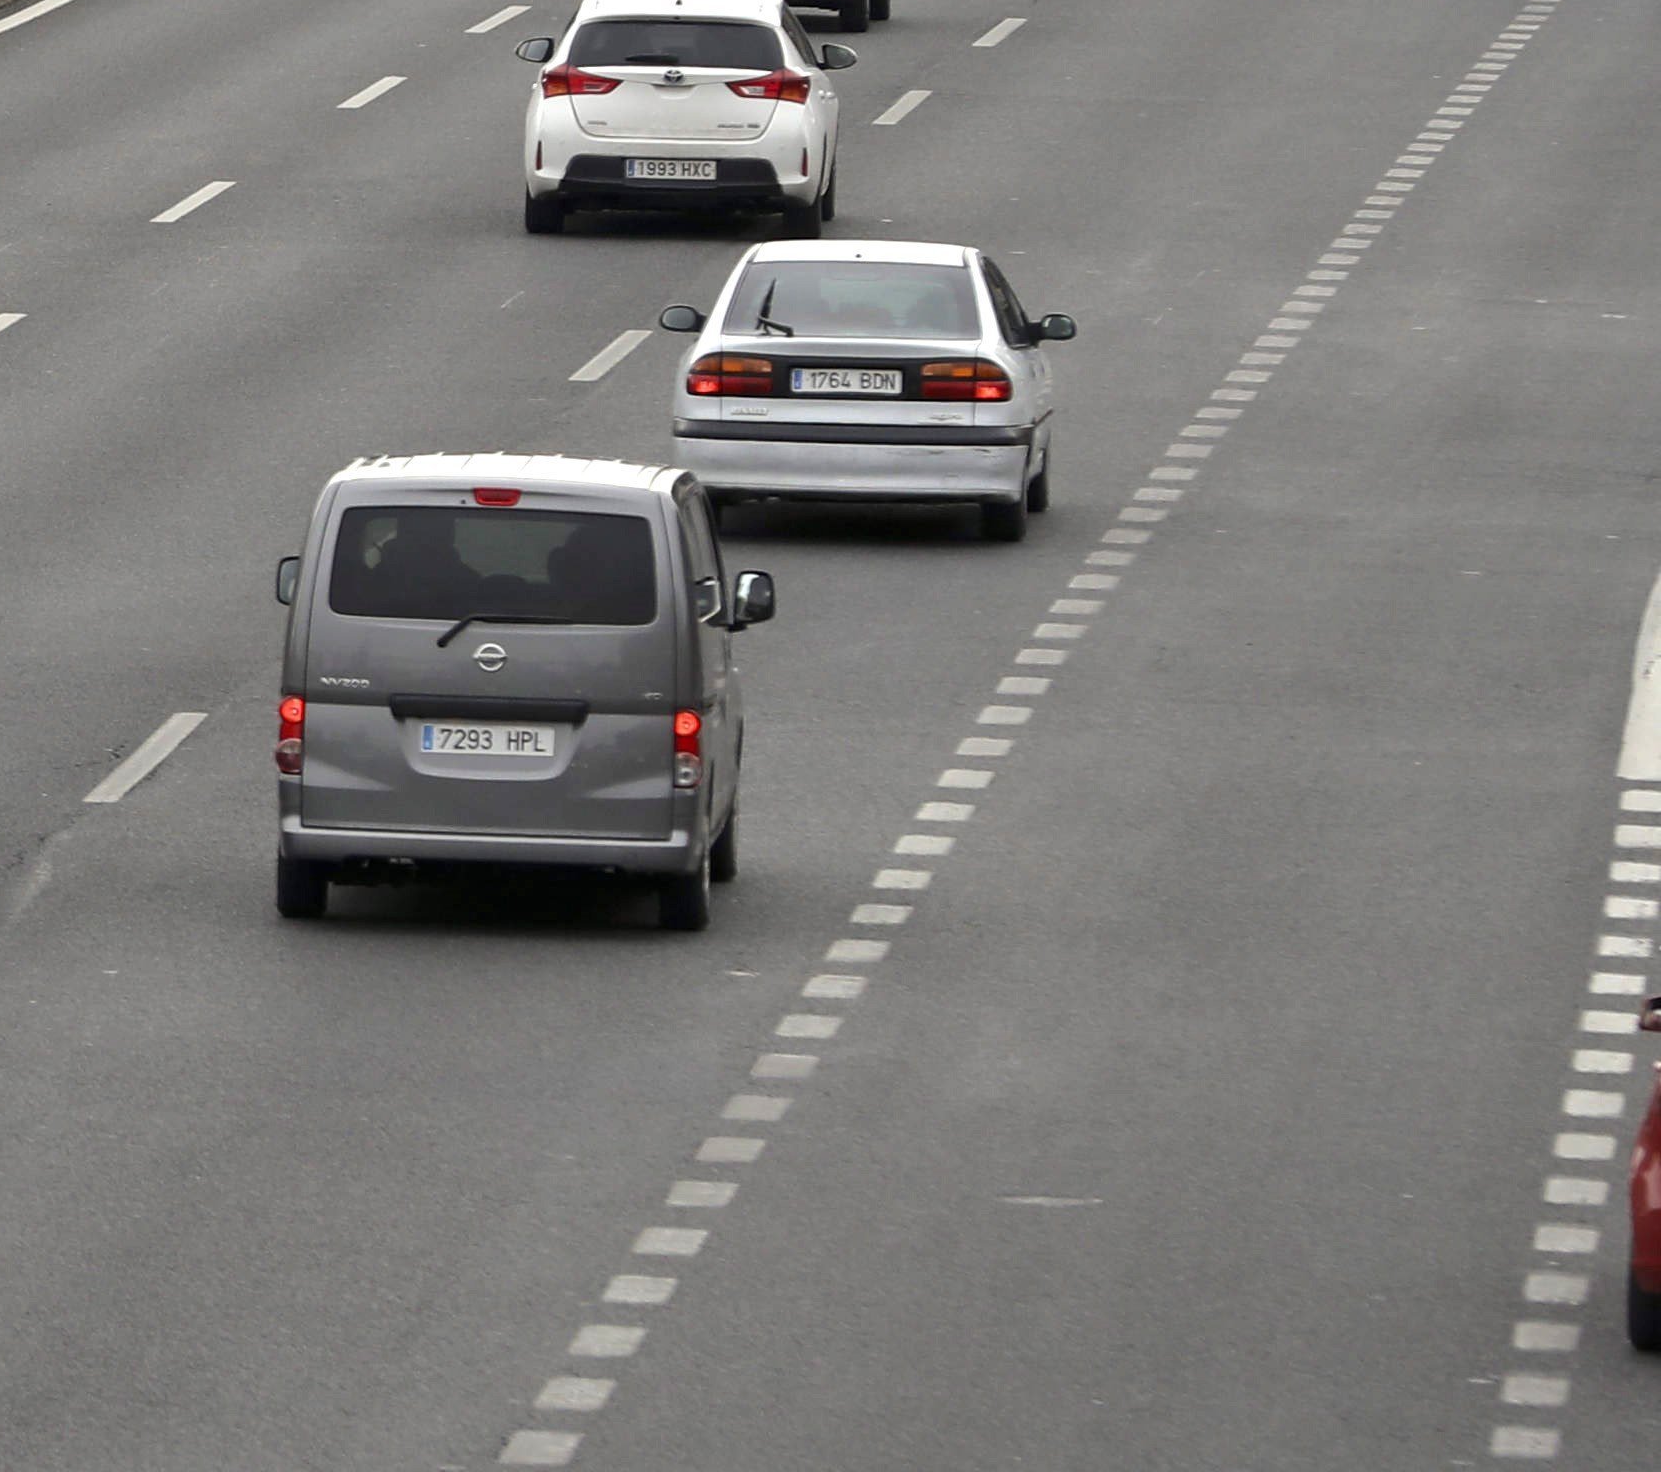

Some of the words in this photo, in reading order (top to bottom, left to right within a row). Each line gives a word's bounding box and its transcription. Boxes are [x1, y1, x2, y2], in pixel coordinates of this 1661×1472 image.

[638, 162, 678, 176] 1993
[681, 163, 712, 177] HXC
[810, 372, 852, 389] 1764
[860, 373, 896, 390] BDN
[440, 729, 493, 750] 7293
[507, 731, 546, 751] HPL
